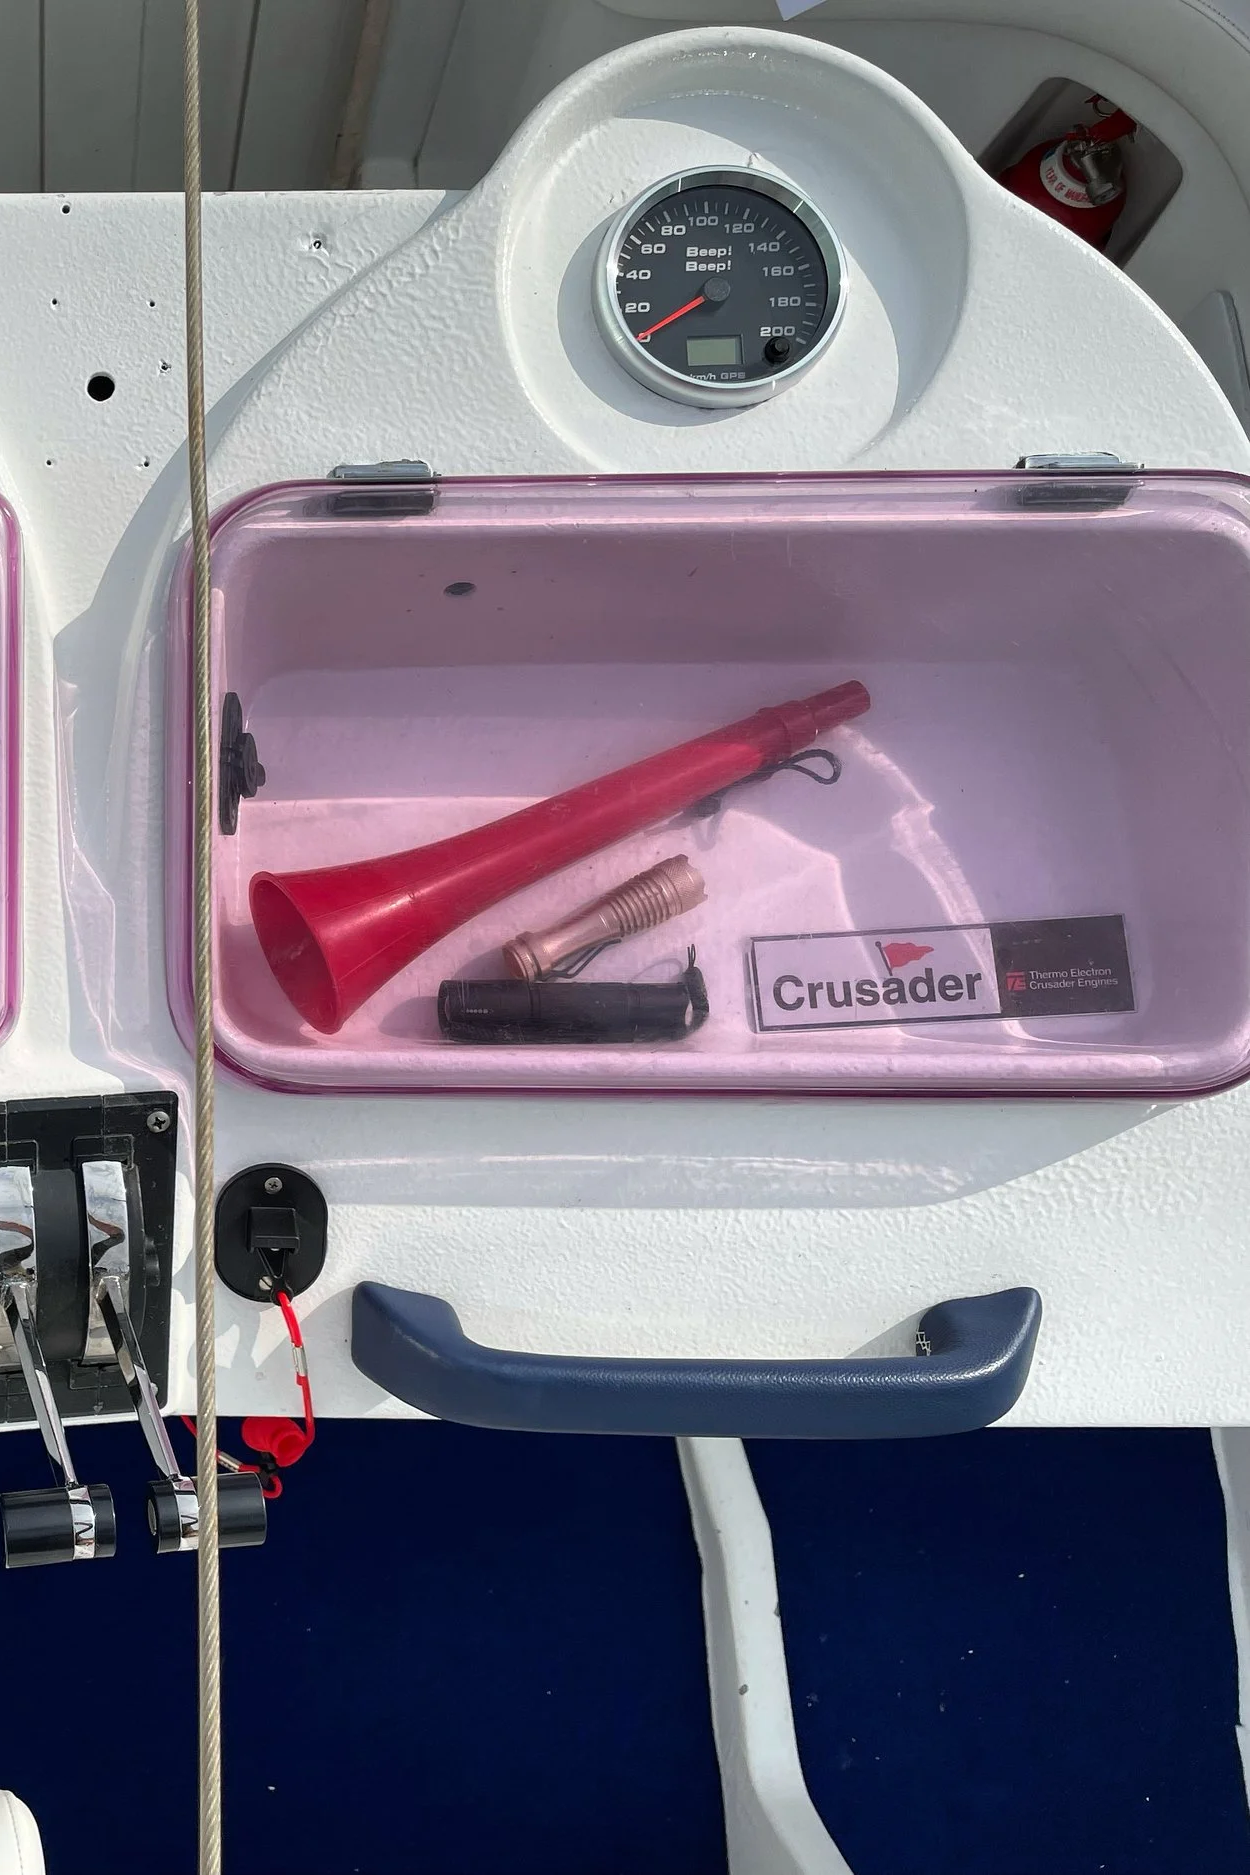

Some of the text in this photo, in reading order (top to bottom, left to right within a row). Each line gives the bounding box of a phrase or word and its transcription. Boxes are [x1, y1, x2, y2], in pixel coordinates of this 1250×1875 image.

[688, 215, 719, 227] 100
[660, 225, 686, 236] 80
[724, 222, 755, 234] 120
[640, 244, 666, 254] 60
[686, 245, 732, 258] Beep!
[748, 241, 780, 254] 140
[685, 260, 731, 273] Beep!
[762, 266, 795, 277] 160
[625, 269, 651, 280] 40
[625, 302, 650, 313] 20
[769, 297, 801, 307] 180
[759, 326, 795, 337] 200
[720, 372, 746, 380] GPS
[1029, 967, 1112, 980] Thermo Electron
[772, 967, 982, 1011] Crusader
[1029, 977, 1118, 990] Crusader Engines
